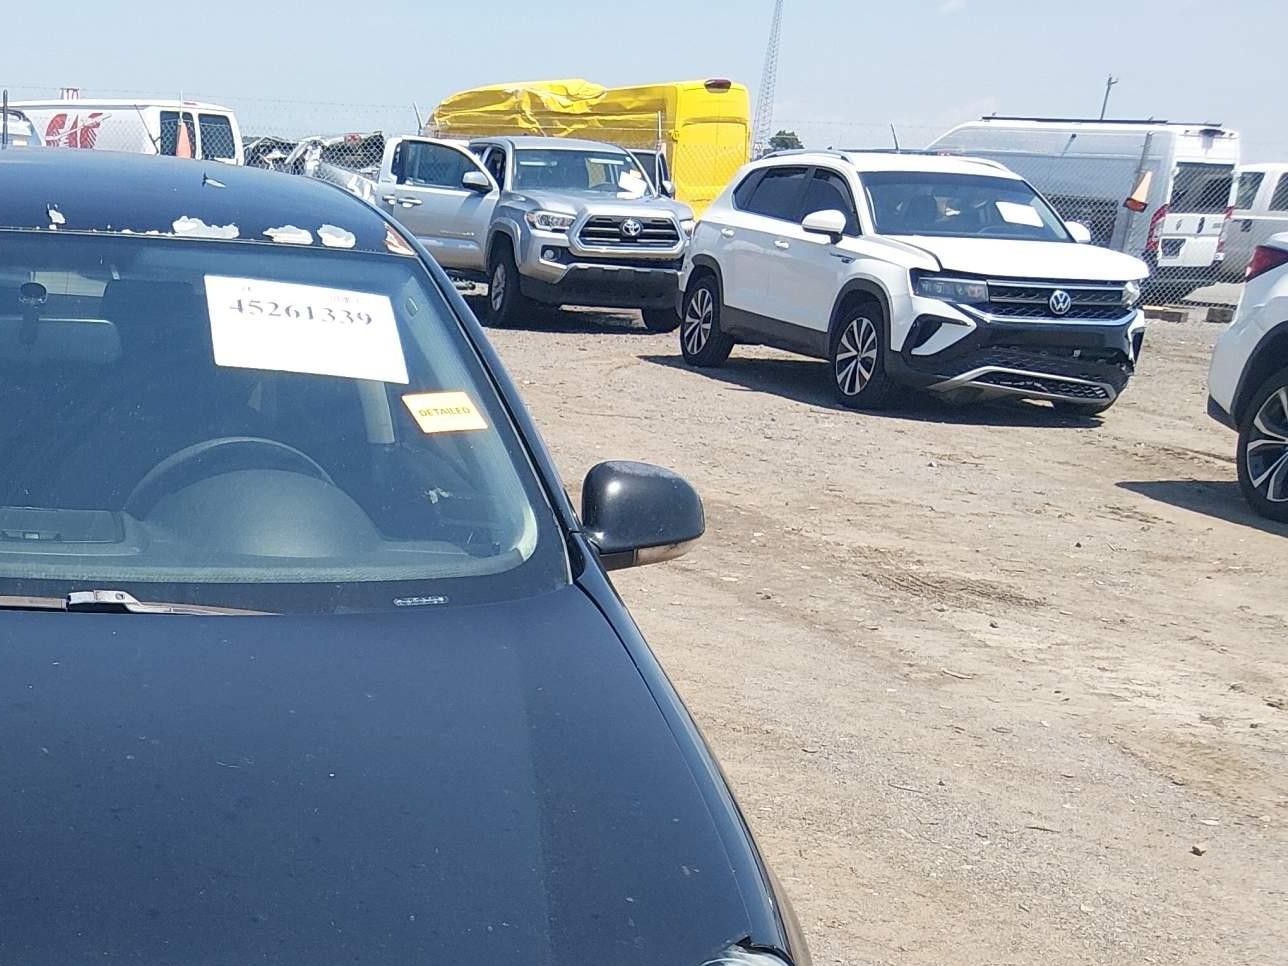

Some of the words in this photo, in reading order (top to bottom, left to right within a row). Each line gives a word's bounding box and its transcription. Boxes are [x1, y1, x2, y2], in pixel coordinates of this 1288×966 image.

[230, 299, 372, 325] 45261339
[1050, 290, 1071, 314] VW
[418, 406, 471, 417] DETAILED
